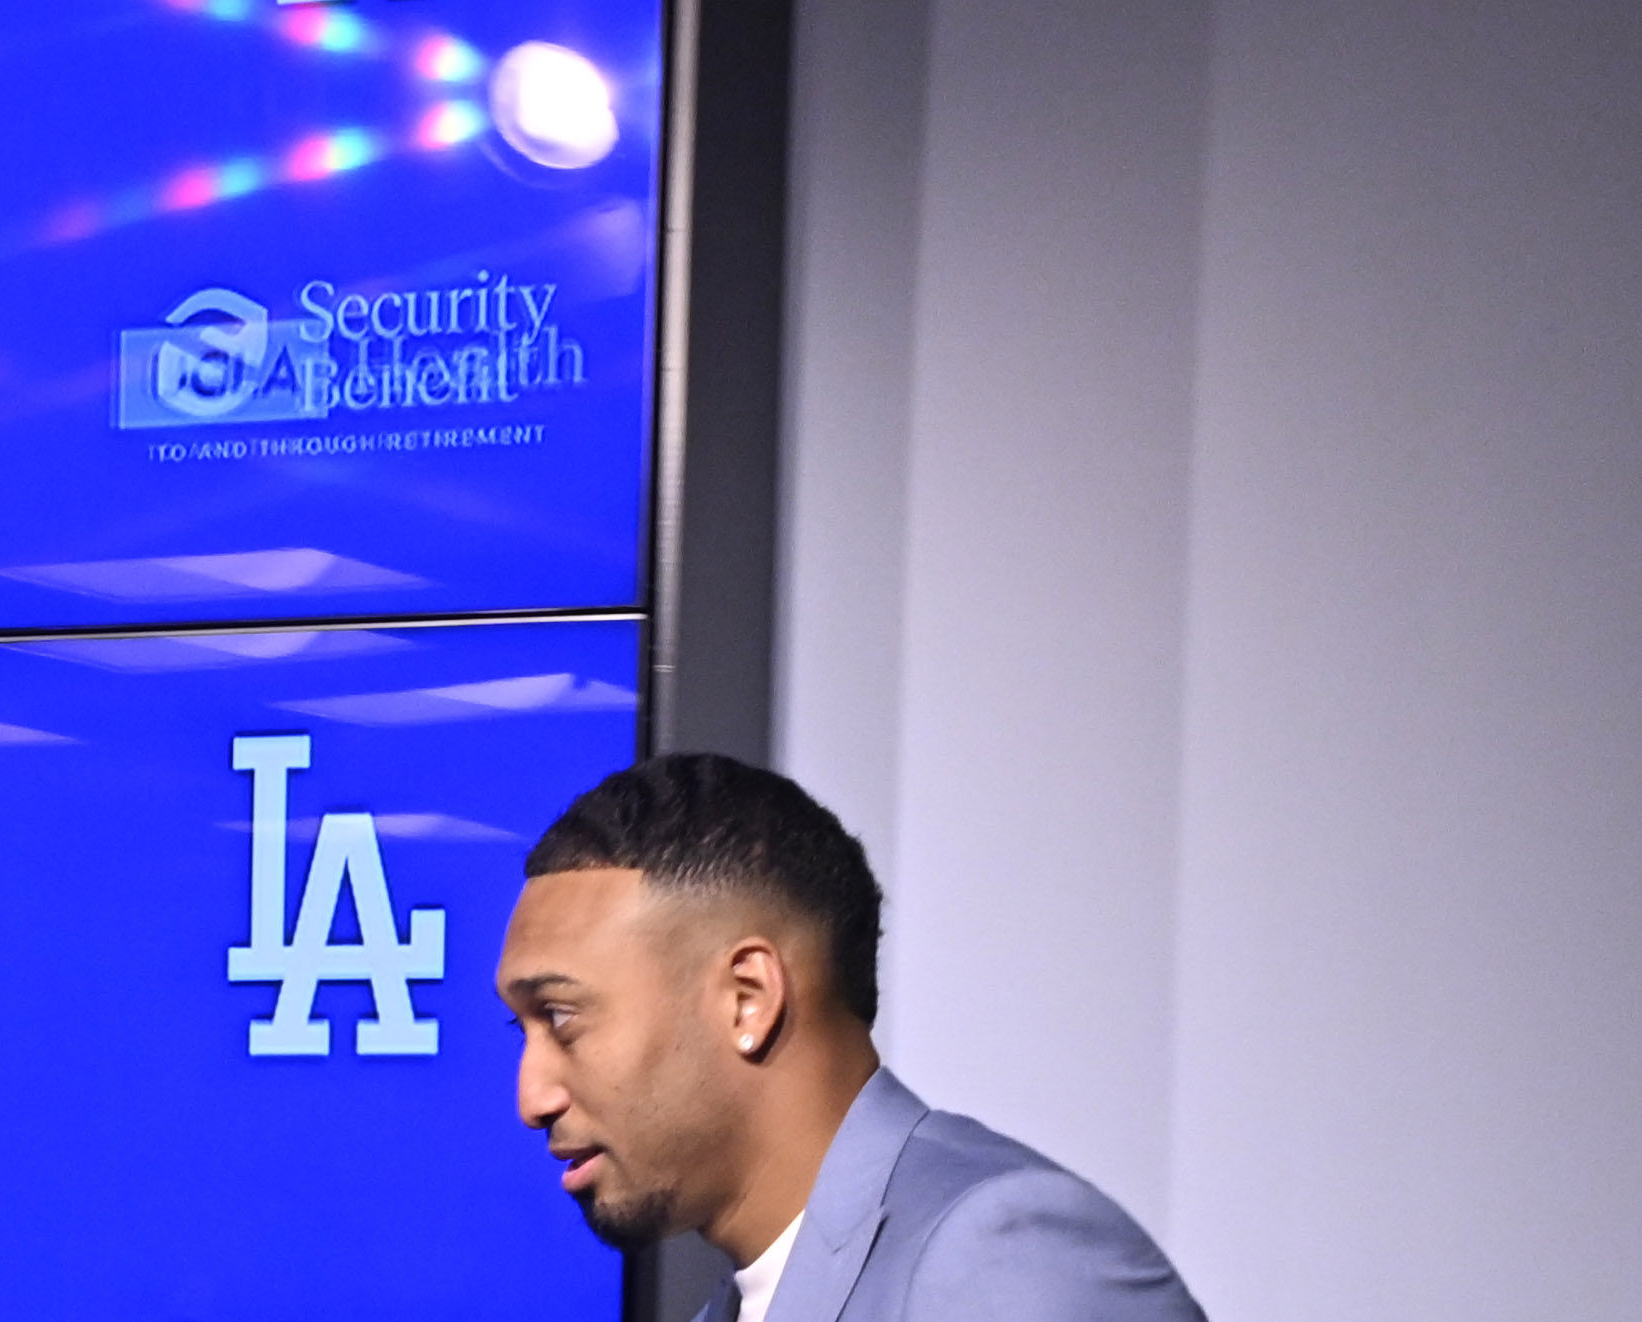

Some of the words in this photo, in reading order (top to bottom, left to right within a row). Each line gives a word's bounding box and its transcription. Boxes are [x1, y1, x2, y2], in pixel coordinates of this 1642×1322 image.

[299, 270, 555, 337] Security
[299, 342, 520, 413] Benefit
[227, 735, 446, 1056] LA
